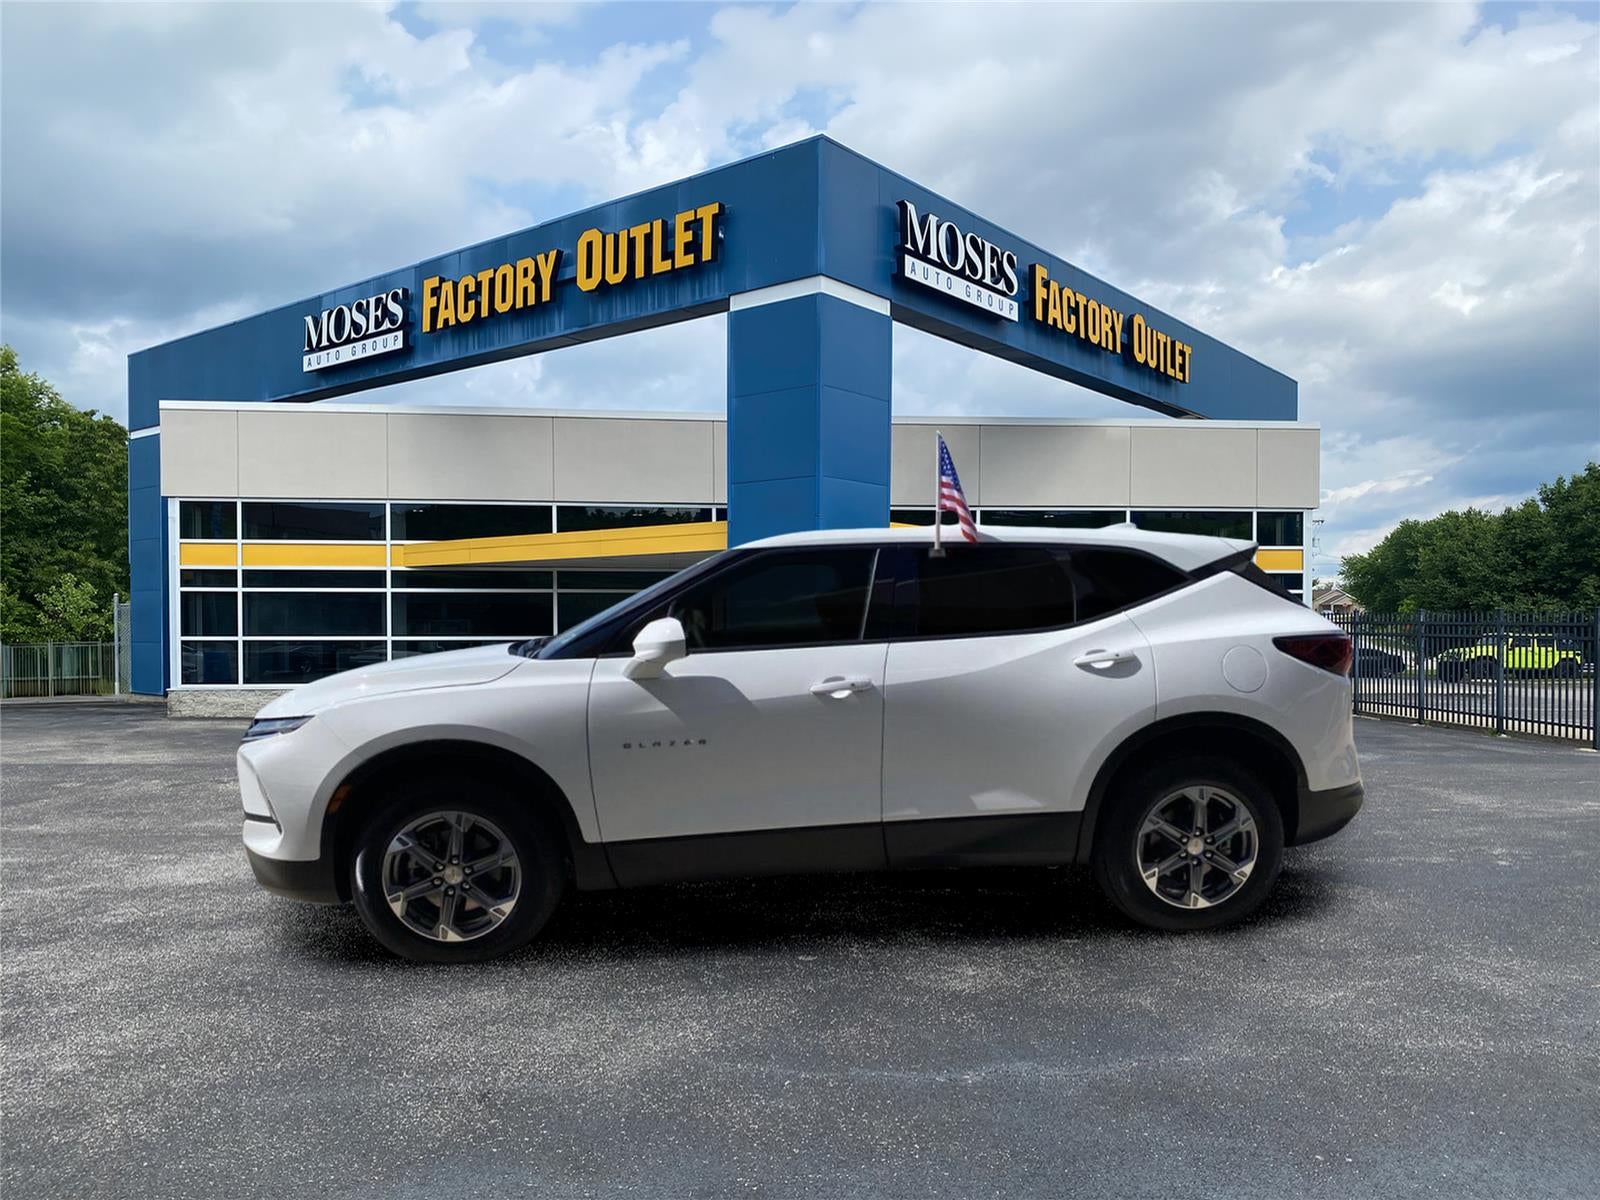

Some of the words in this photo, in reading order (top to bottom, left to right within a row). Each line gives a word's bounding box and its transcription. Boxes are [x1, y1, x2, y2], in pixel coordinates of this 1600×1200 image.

[422, 249, 560, 333] FACTORY
[576, 202, 721, 292] OUTLET
[904, 200, 1019, 297] MOSES
[909, 260, 953, 291] AUTO
[965, 278, 1015, 315] GROUP
[303, 289, 404, 351] MOSES
[1034, 263, 1124, 353] FACTORY
[1131, 313, 1192, 384] OUTLET
[307, 350, 340, 369] AUTO
[350, 334, 400, 357] GROUP
[623, 739, 707, 750] BLAZER
